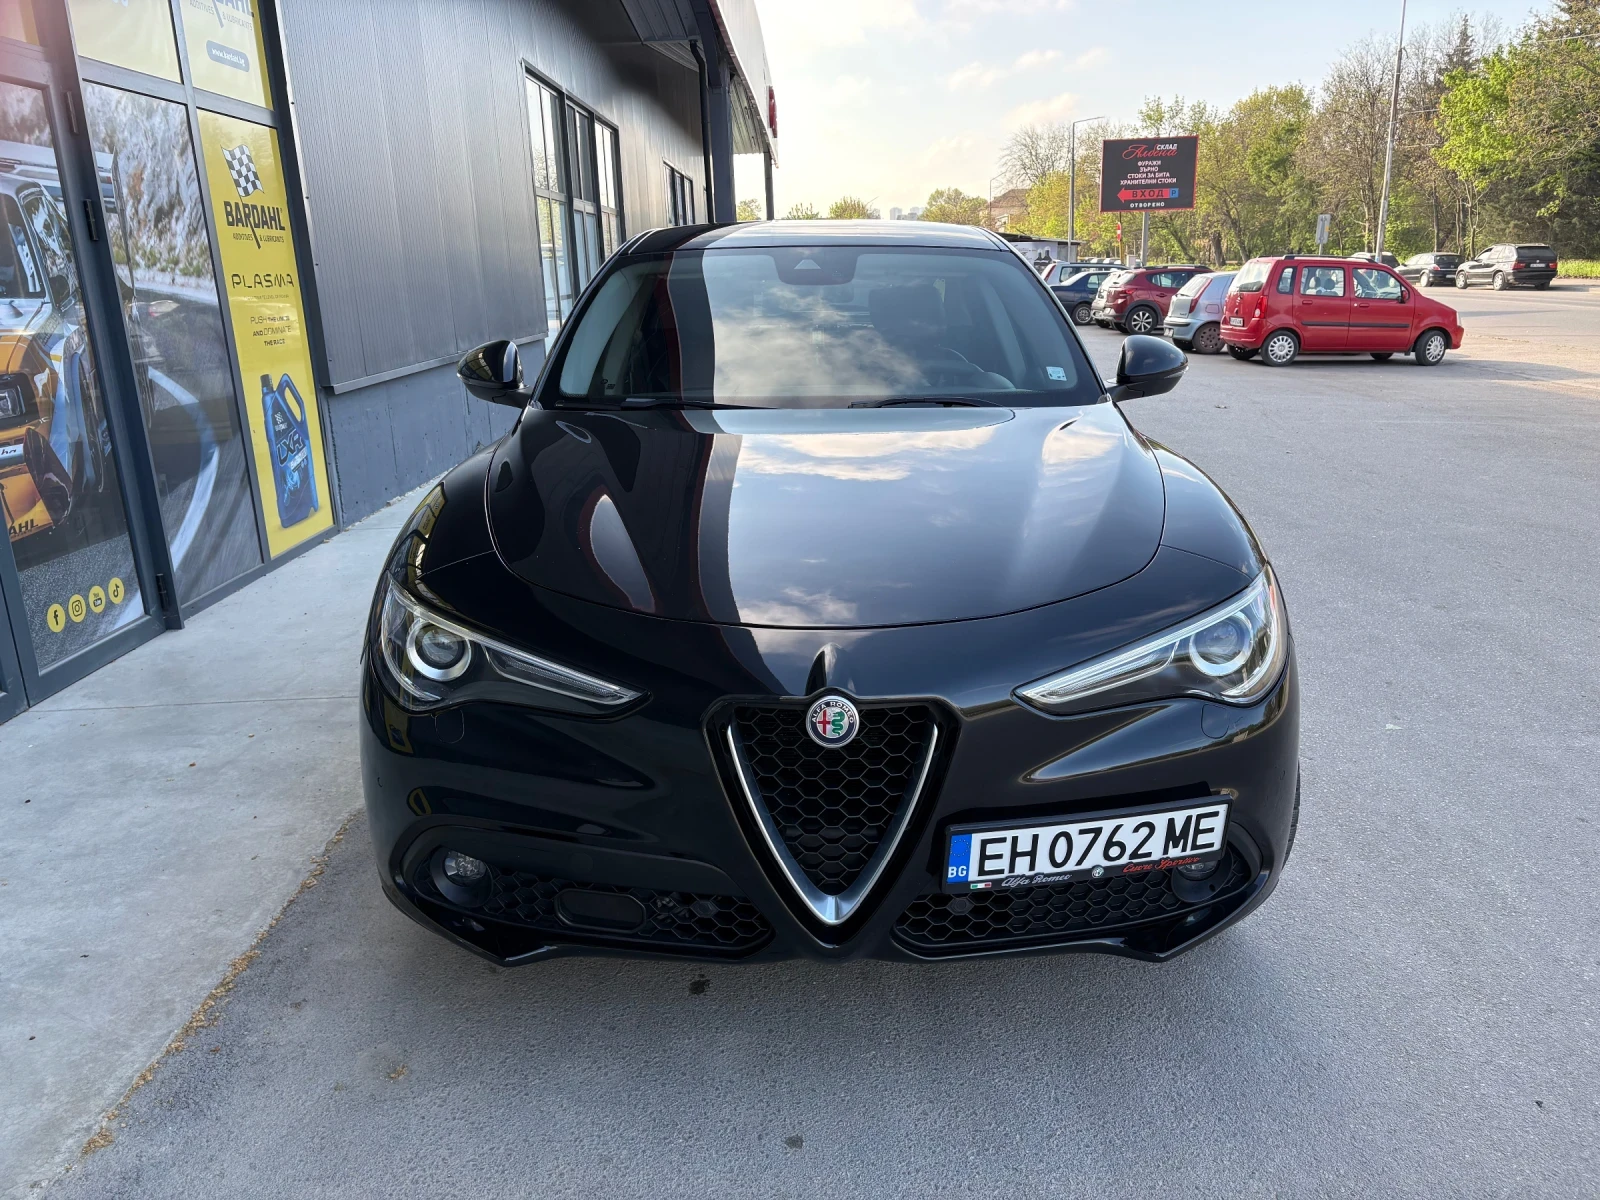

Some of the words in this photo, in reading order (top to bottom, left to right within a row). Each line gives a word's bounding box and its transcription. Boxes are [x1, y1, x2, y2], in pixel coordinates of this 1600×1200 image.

[1131, 189, 1164, 198] ВХОД
[223, 200, 286, 231] BARDAHL
[231, 273, 295, 289] PLASMA
[250, 315, 267, 325] PUSH
[811, 703, 827, 723] ALFA
[829, 701, 854, 724] ROMEO
[977, 833, 1040, 877] EH
[1048, 821, 1156, 869] 0762
[1162, 810, 1220, 855] ME
[947, 865, 968, 878] BG
[1001, 876, 1031, 887] Alfa
[1032, 873, 1073, 884] Romeo
